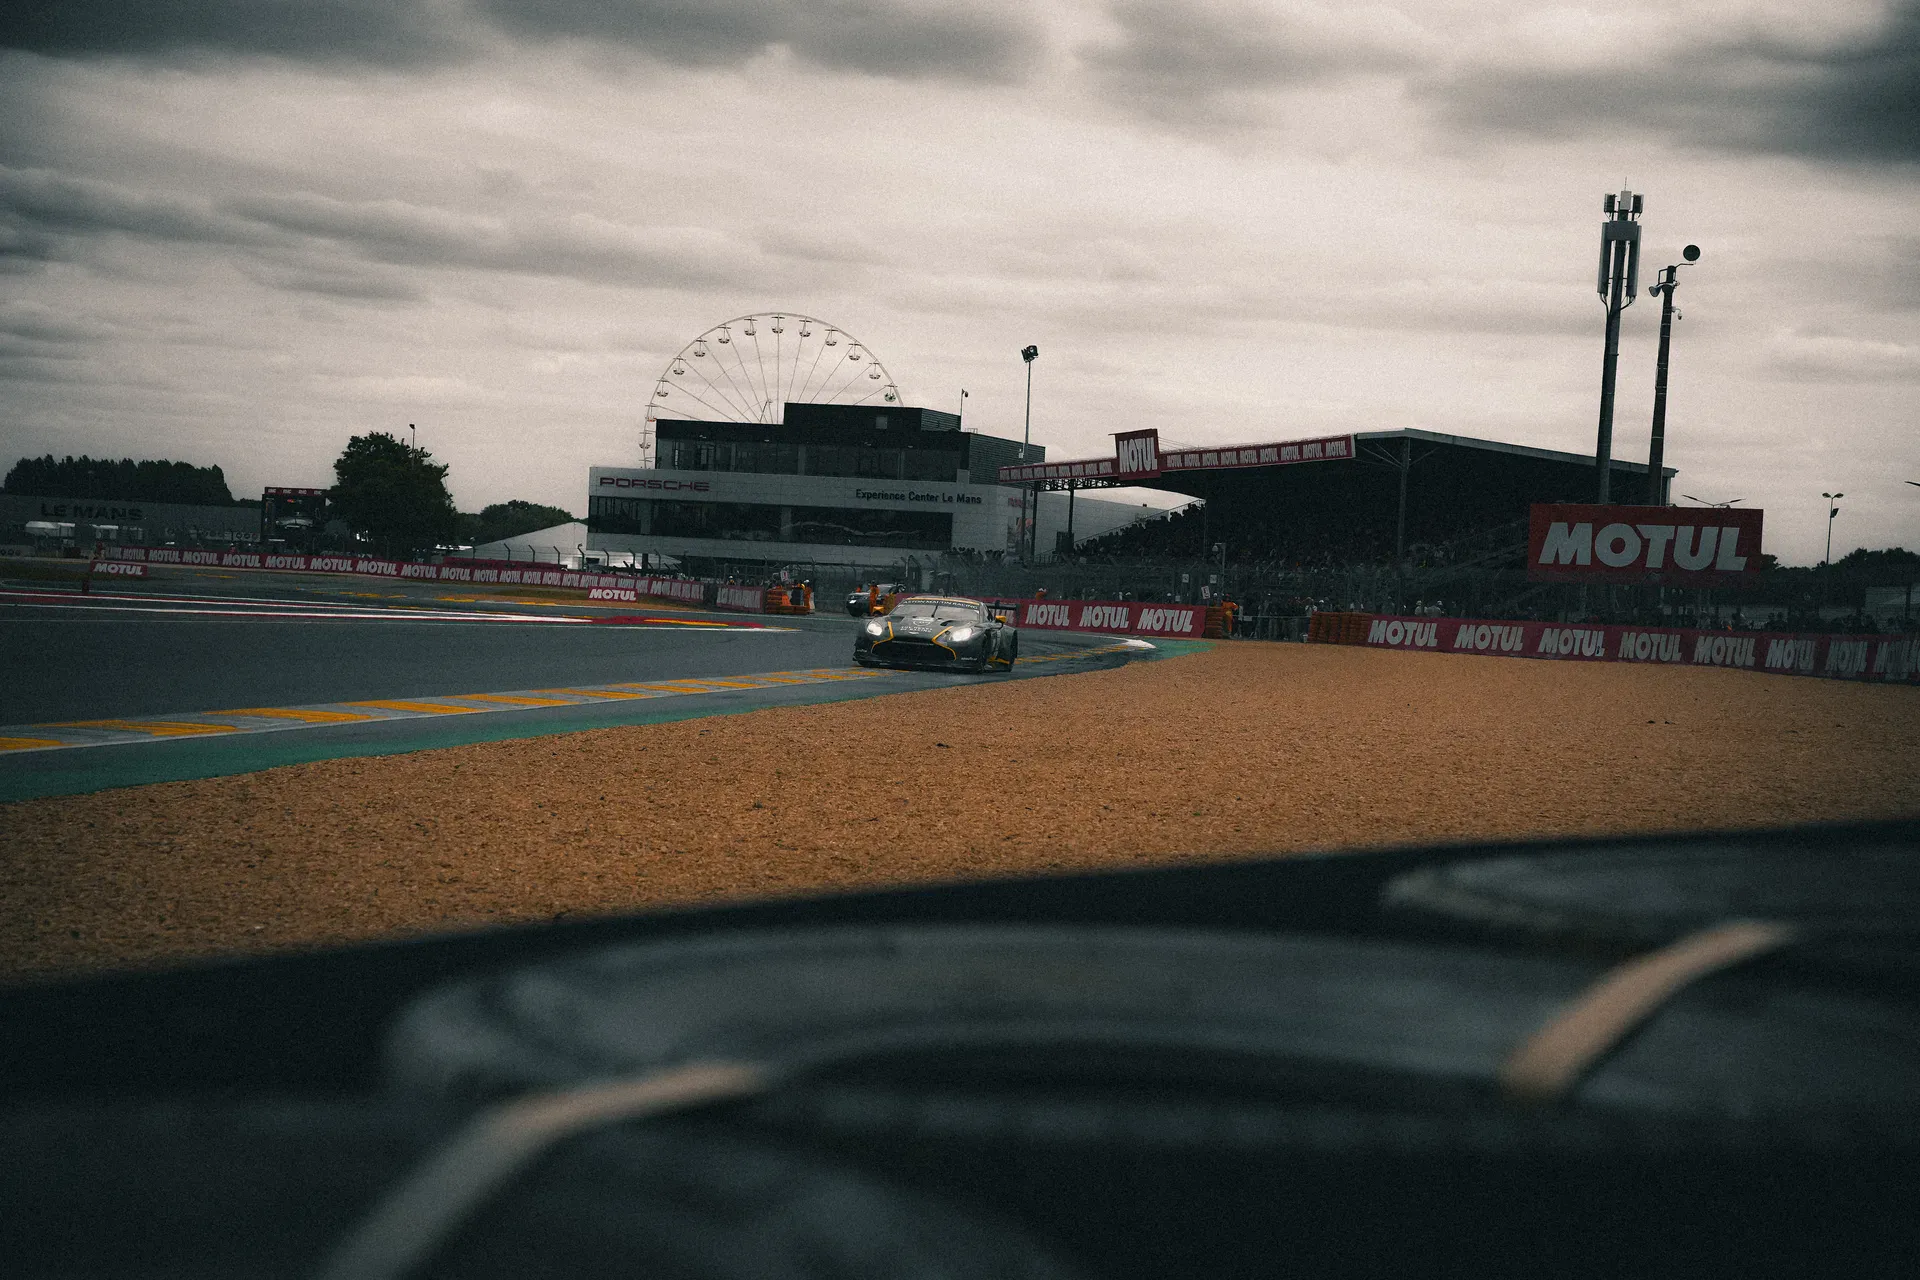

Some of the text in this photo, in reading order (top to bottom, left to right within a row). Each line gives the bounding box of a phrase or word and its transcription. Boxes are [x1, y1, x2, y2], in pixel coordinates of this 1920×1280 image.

[1119, 436, 1158, 473] MOTUL
[1281, 445, 1300, 461] MOTUL
[1303, 442, 1323, 459] MOTUL
[1326, 440, 1347, 457] MOTUL
[600, 477, 710, 492] PORSCHE
[856, 489, 982, 504] Experience Center Le Mans
[41, 503, 142, 520] LE MANS
[1538, 521, 1748, 572] MOTUL
[93, 563, 143, 575] MOTUL
[148, 549, 181, 563] MOTUL
[183, 551, 218, 565] MOTUL
[222, 552, 261, 568] MOTUL
[265, 554, 306, 570] MOTUL
[310, 557, 353, 572] MOTUL
[356, 559, 398, 575] MOTUL
[401, 563, 438, 579] MOTUL
[440, 567, 471, 580] MOTUL
[473, 569, 498, 582] MOTUL
[500, 570, 521, 584] MOTUL
[589, 589, 637, 601] MOTUL
[1025, 604, 1071, 627] MOTUL
[1078, 606, 1129, 629] MOTUL
[1137, 607, 1194, 632] MOTUL
[1368, 620, 1438, 647] MOTUL
[1454, 624, 1524, 651] MOTUL
[1538, 628, 1605, 657] MOTUL
[1618, 631, 1683, 661] MOTUL
[1693, 635, 1756, 667] MOTUL
